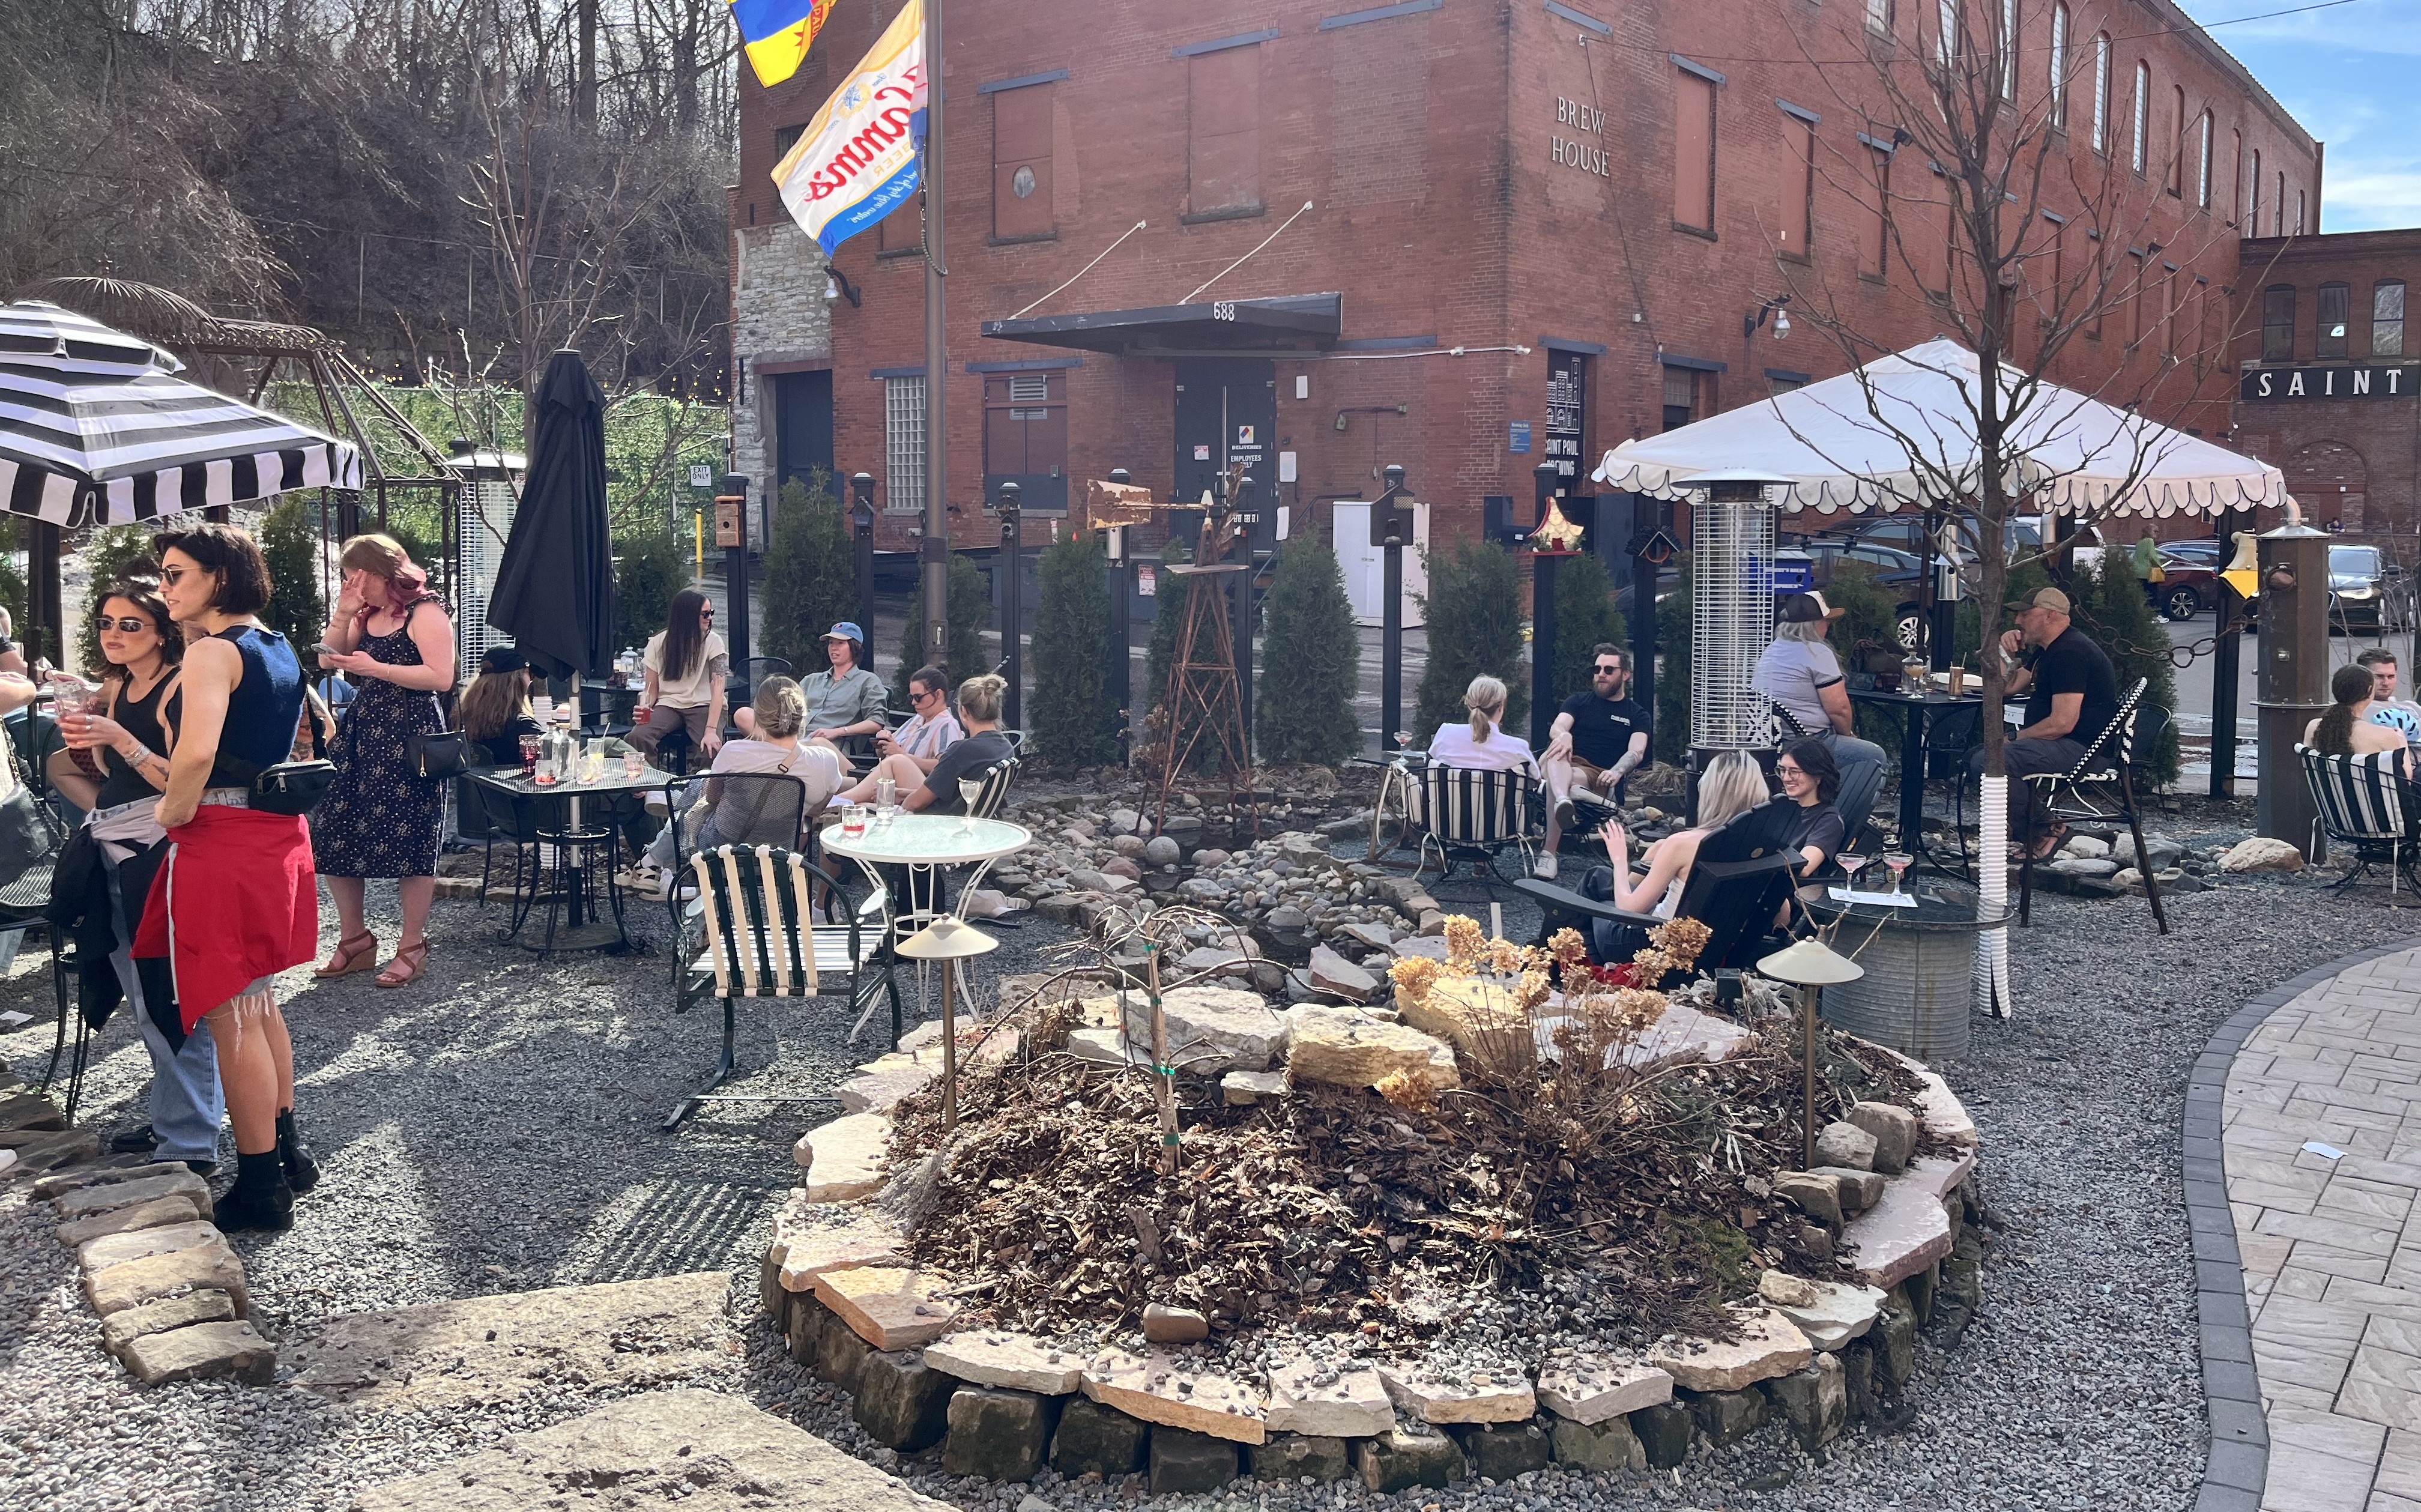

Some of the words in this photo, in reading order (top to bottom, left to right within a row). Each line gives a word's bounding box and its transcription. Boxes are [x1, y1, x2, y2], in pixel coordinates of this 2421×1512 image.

[1557, 96, 1606, 135] BREW
[1552, 136, 1609, 177] HOUSE
[1214, 302, 1235, 321] 688
[2258, 369, 2402, 396] SAINT
[1562, 440, 1579, 456] PAUL
[1547, 459, 1574, 476] WING
